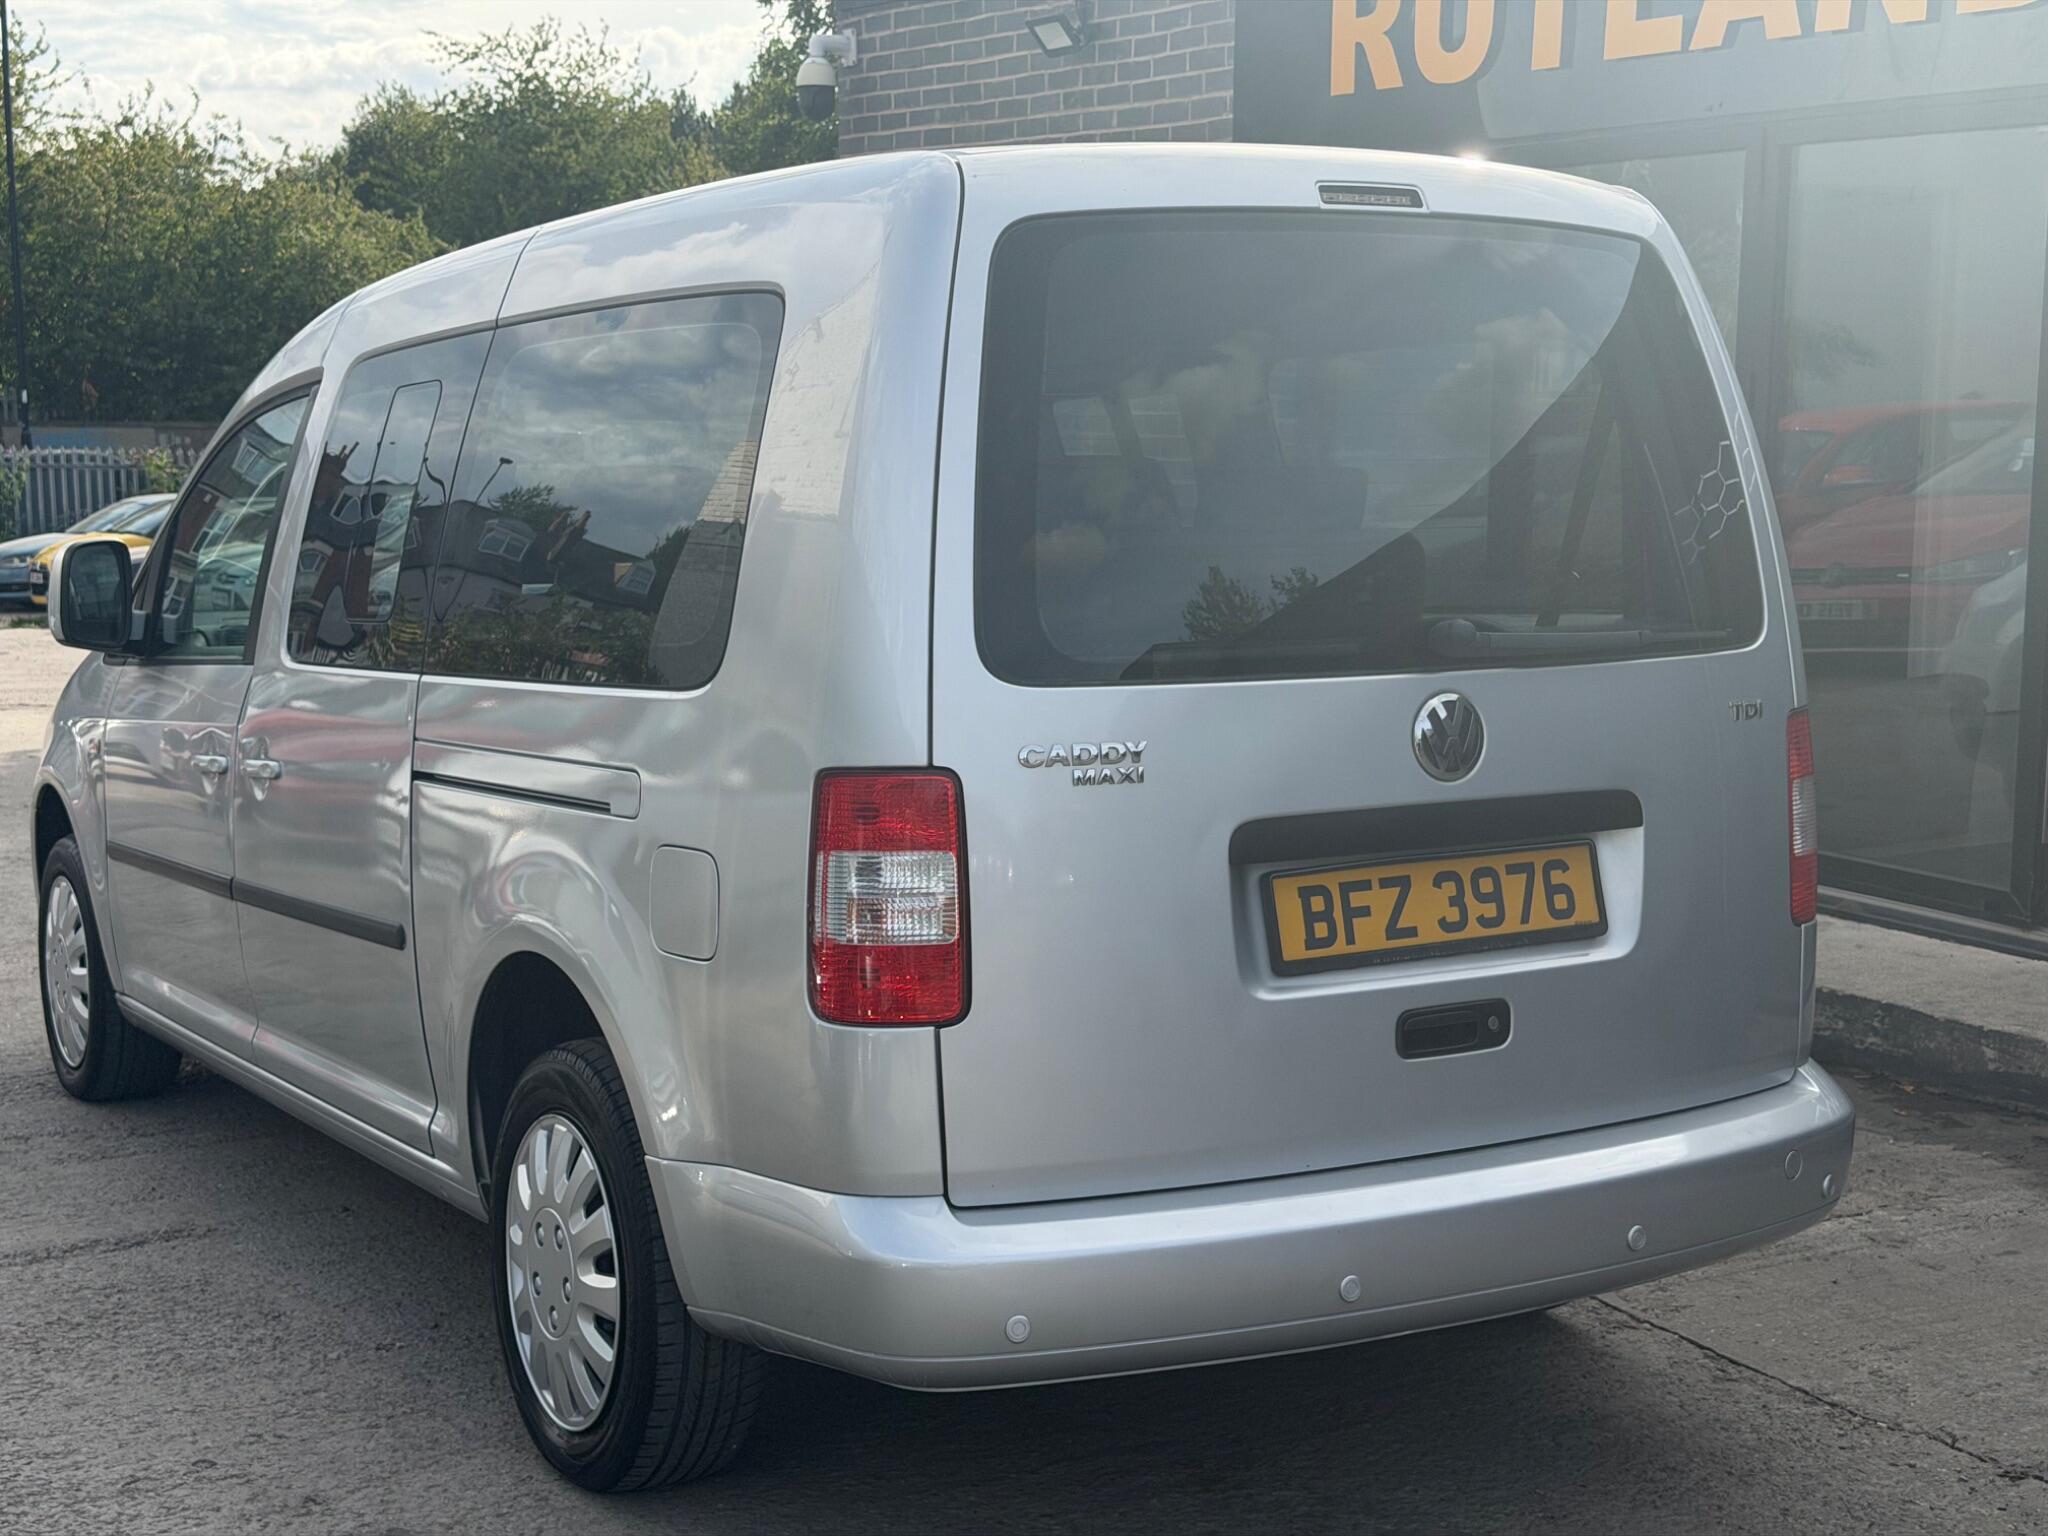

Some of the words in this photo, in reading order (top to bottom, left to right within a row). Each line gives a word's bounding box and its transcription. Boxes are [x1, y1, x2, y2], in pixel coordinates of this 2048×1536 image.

[1330, 0, 2038, 96] RULA
[1018, 740, 1147, 768] CADDY
[1072, 767, 1144, 787] MAXI
[1297, 874, 1419, 951] BFZ
[1431, 859, 1577, 934] 3976
